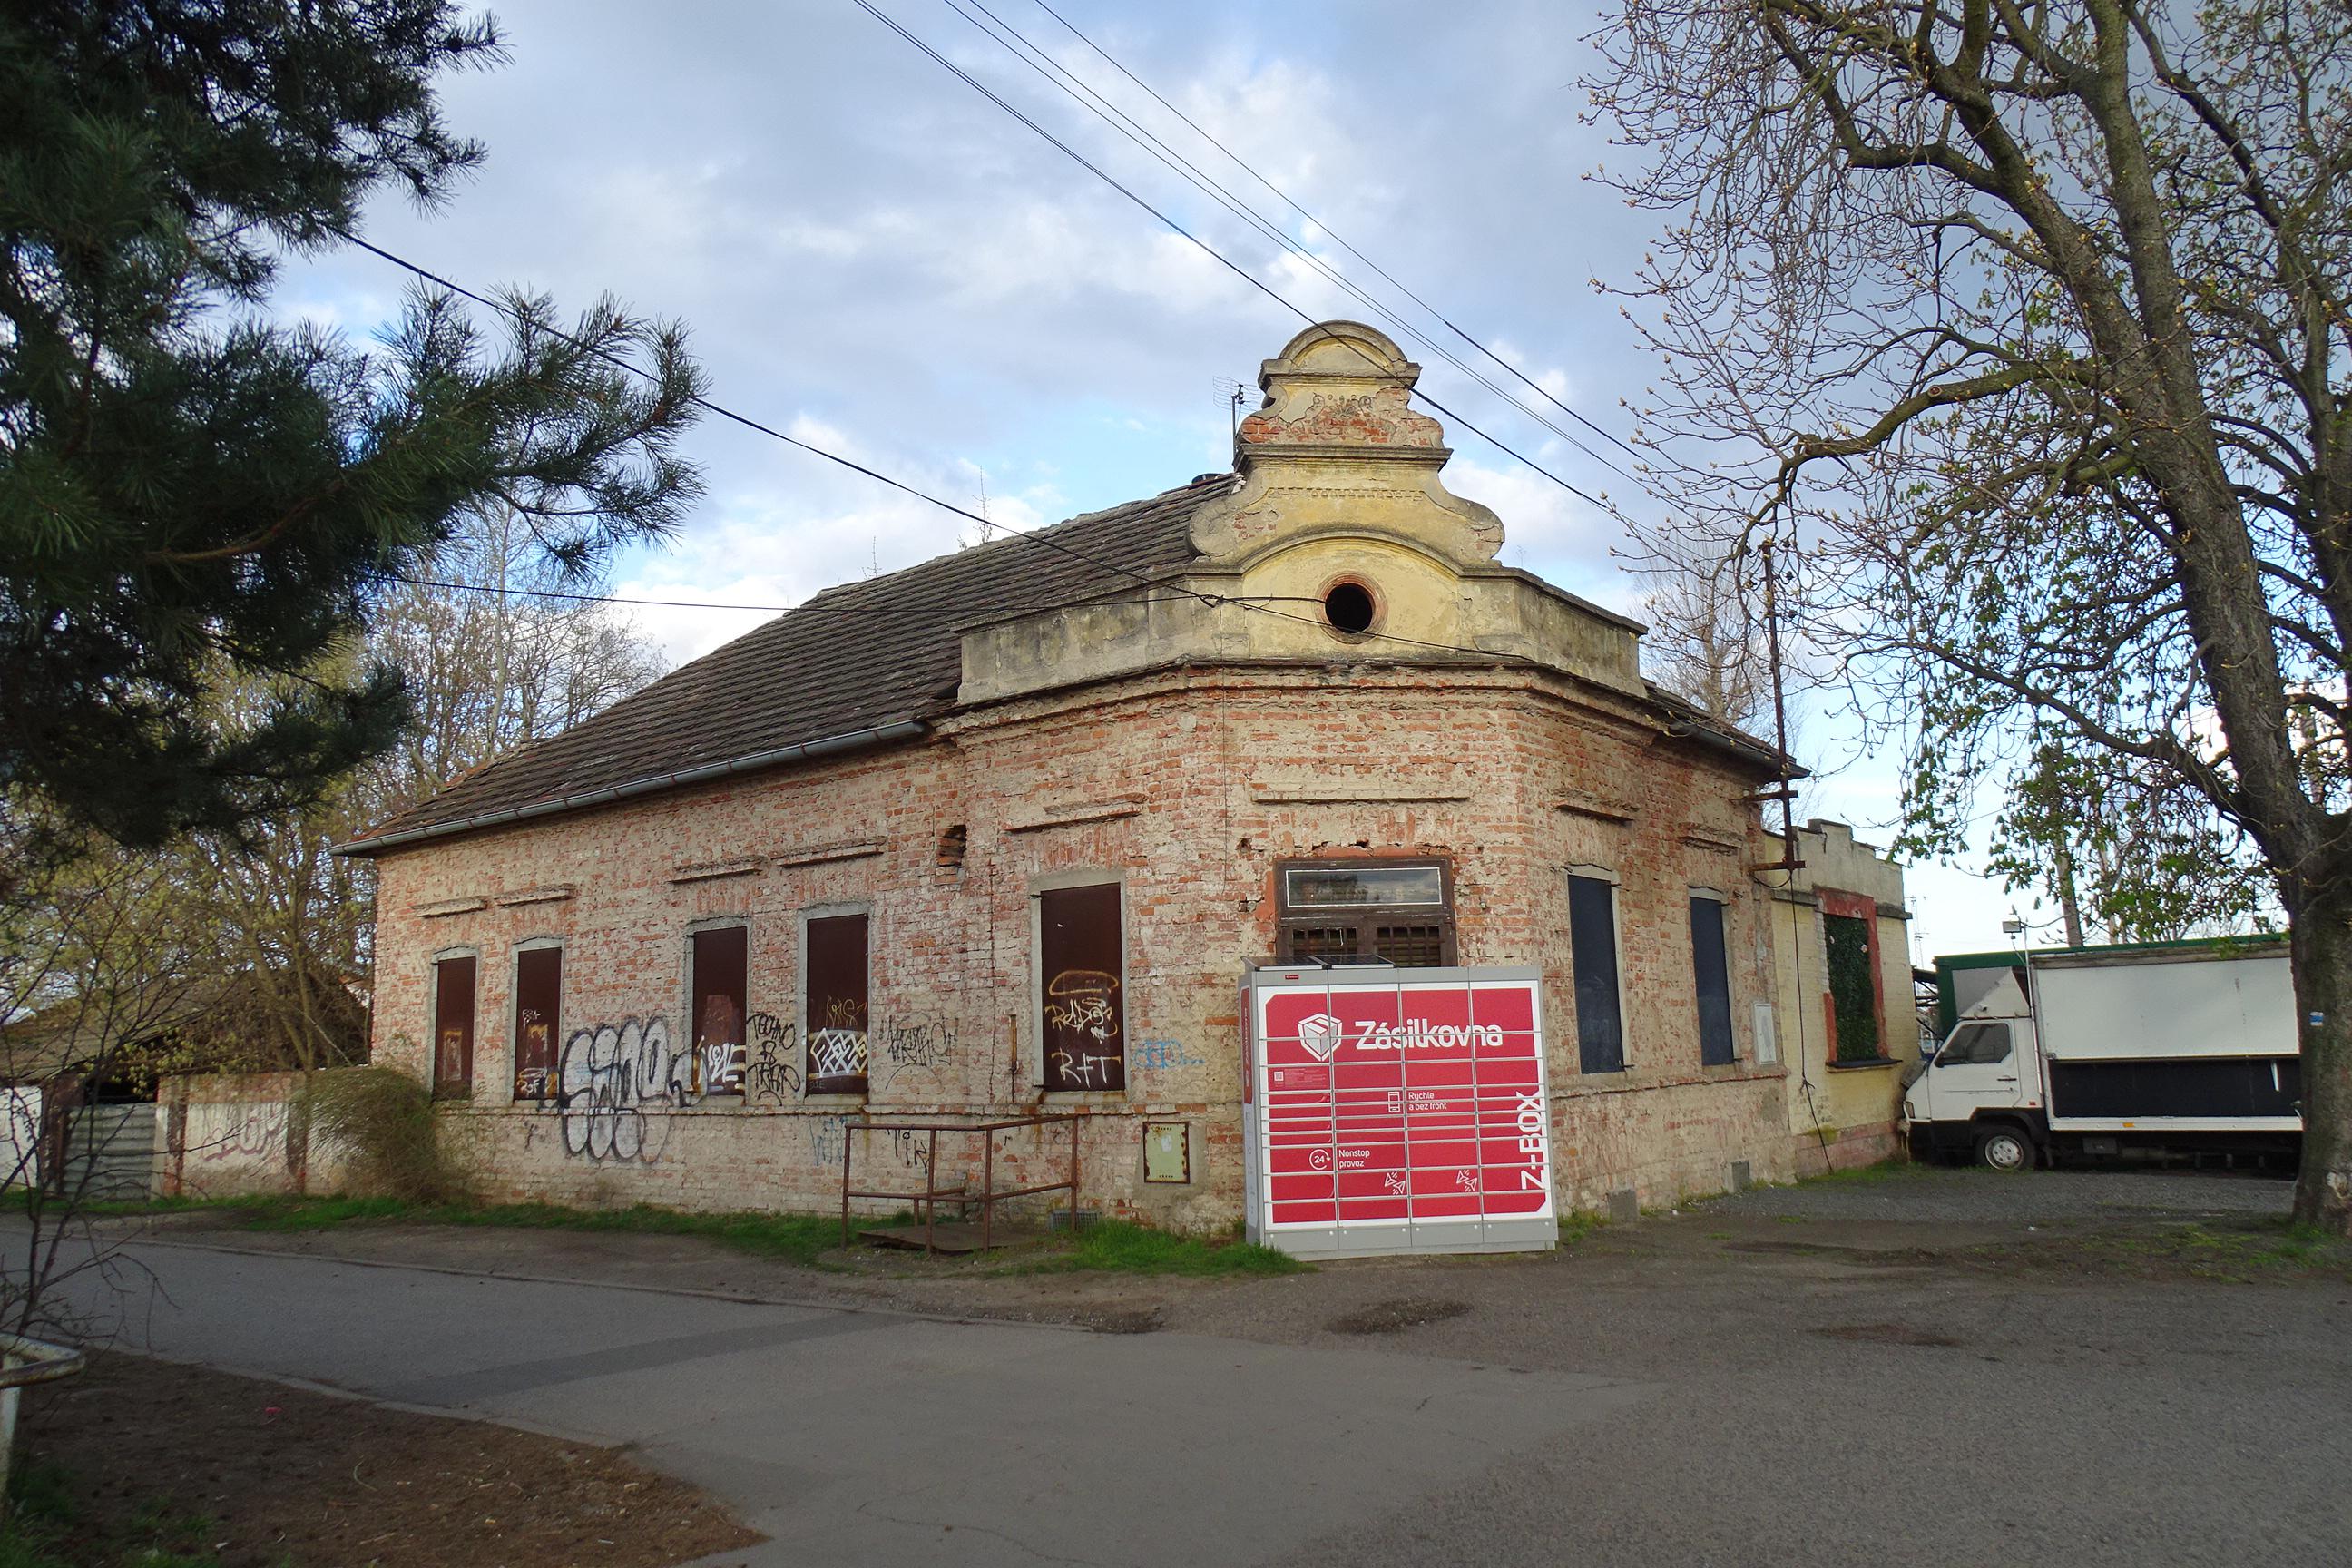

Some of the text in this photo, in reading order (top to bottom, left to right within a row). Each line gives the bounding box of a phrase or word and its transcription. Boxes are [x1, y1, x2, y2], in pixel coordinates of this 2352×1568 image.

[1354, 1018, 1504, 1050] Zásilkovna
[1408, 1092, 1435, 1101] Rychle
[1415, 1102, 1429, 1111] bez
[1429, 1102, 1447, 1111] front
[1515, 1091, 1546, 1190] Z-BOX
[1338, 1149, 1370, 1158] Nonstop
[1314, 1155, 1325, 1164] 24
[1338, 1161, 1365, 1169] provoz
